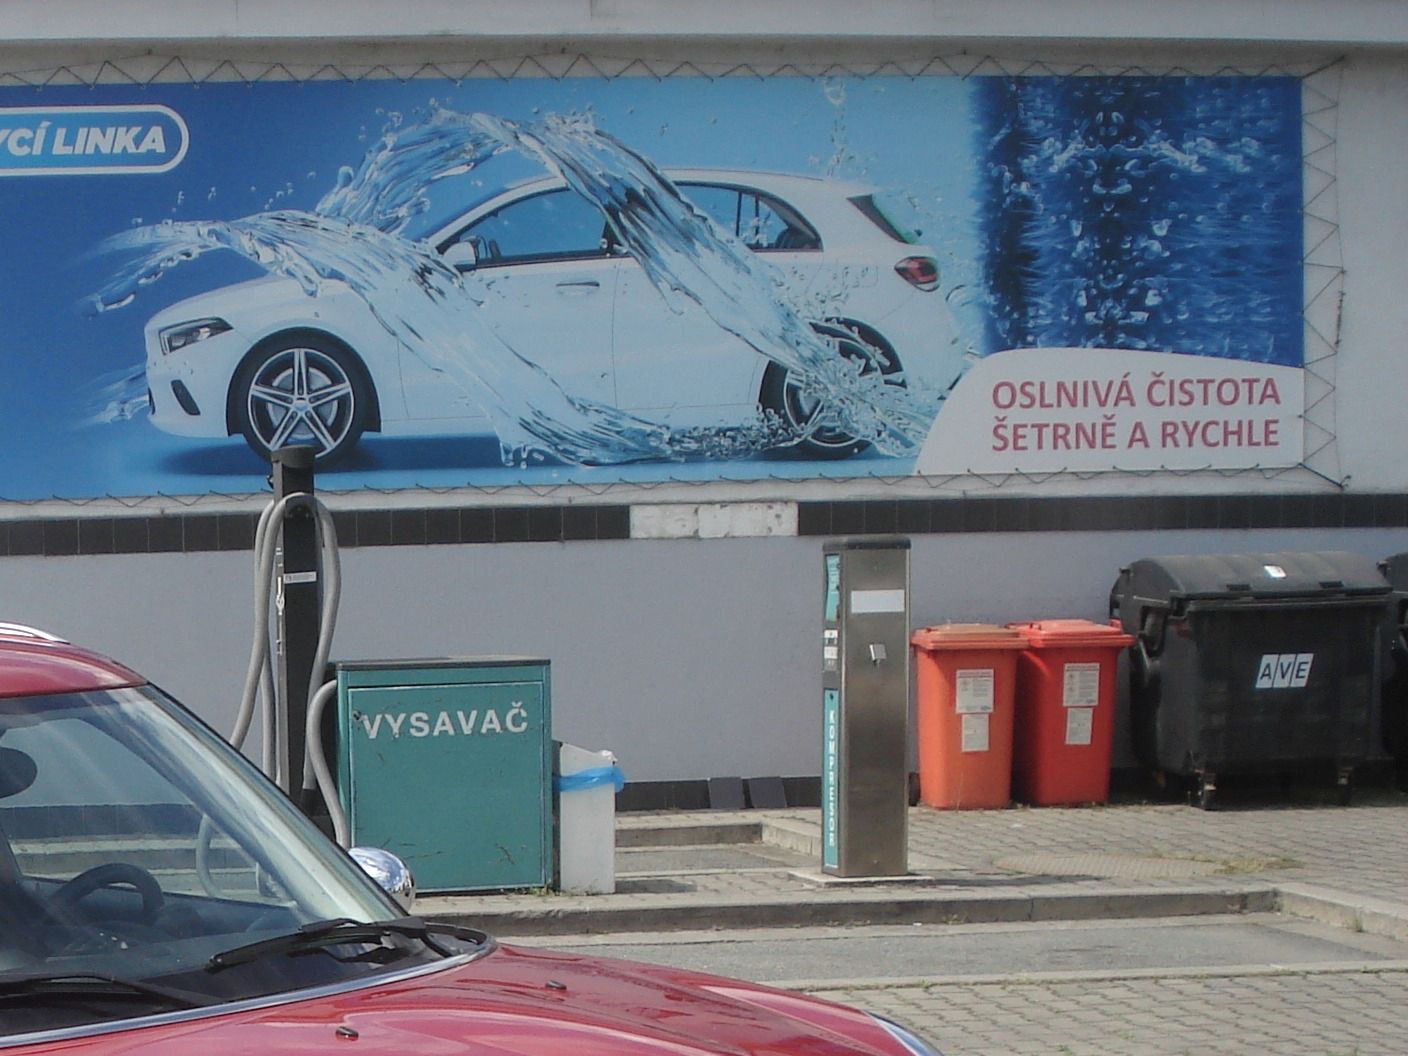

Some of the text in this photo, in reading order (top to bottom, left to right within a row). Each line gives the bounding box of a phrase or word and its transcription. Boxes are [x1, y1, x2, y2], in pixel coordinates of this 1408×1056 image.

[52, 126, 166, 155] LINKA
[992, 371, 1281, 409] OSLNIVÁ ČISTOTA
[992, 414, 1280, 452] ŠETRNĚ A RYCHLE
[1260, 661, 1309, 680] AVE
[362, 701, 528, 739] VYSAVAČ
